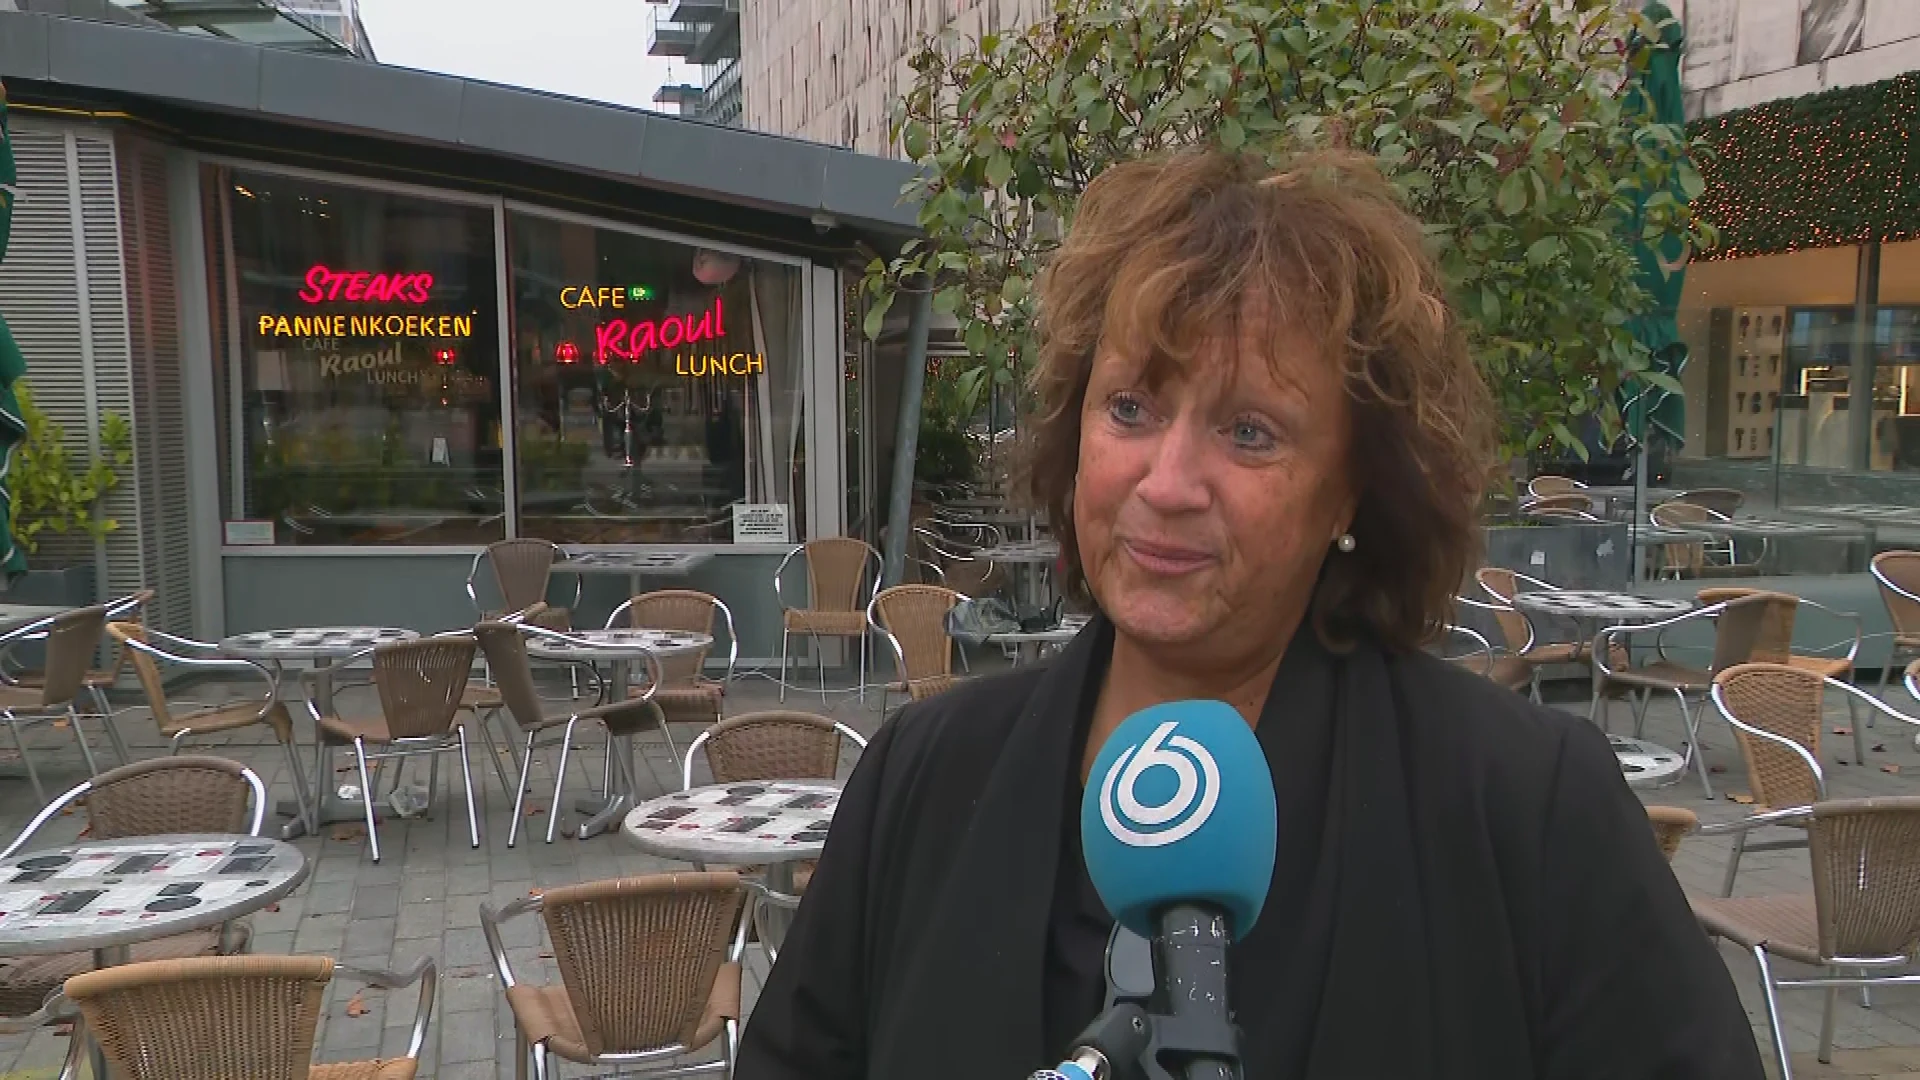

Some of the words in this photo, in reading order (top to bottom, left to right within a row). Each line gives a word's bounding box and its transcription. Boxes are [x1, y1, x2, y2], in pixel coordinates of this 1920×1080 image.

[299, 263, 433, 304] STEAKS
[560, 286, 625, 309] CAFE
[258, 315, 471, 337] PANNENKOEKEN
[596, 297, 727, 364] Raoul
[302, 338, 340, 351] CAFE
[320, 341, 403, 377] Raoul
[676, 353, 763, 376] LUNCH
[367, 369, 418, 385] LUNCH
